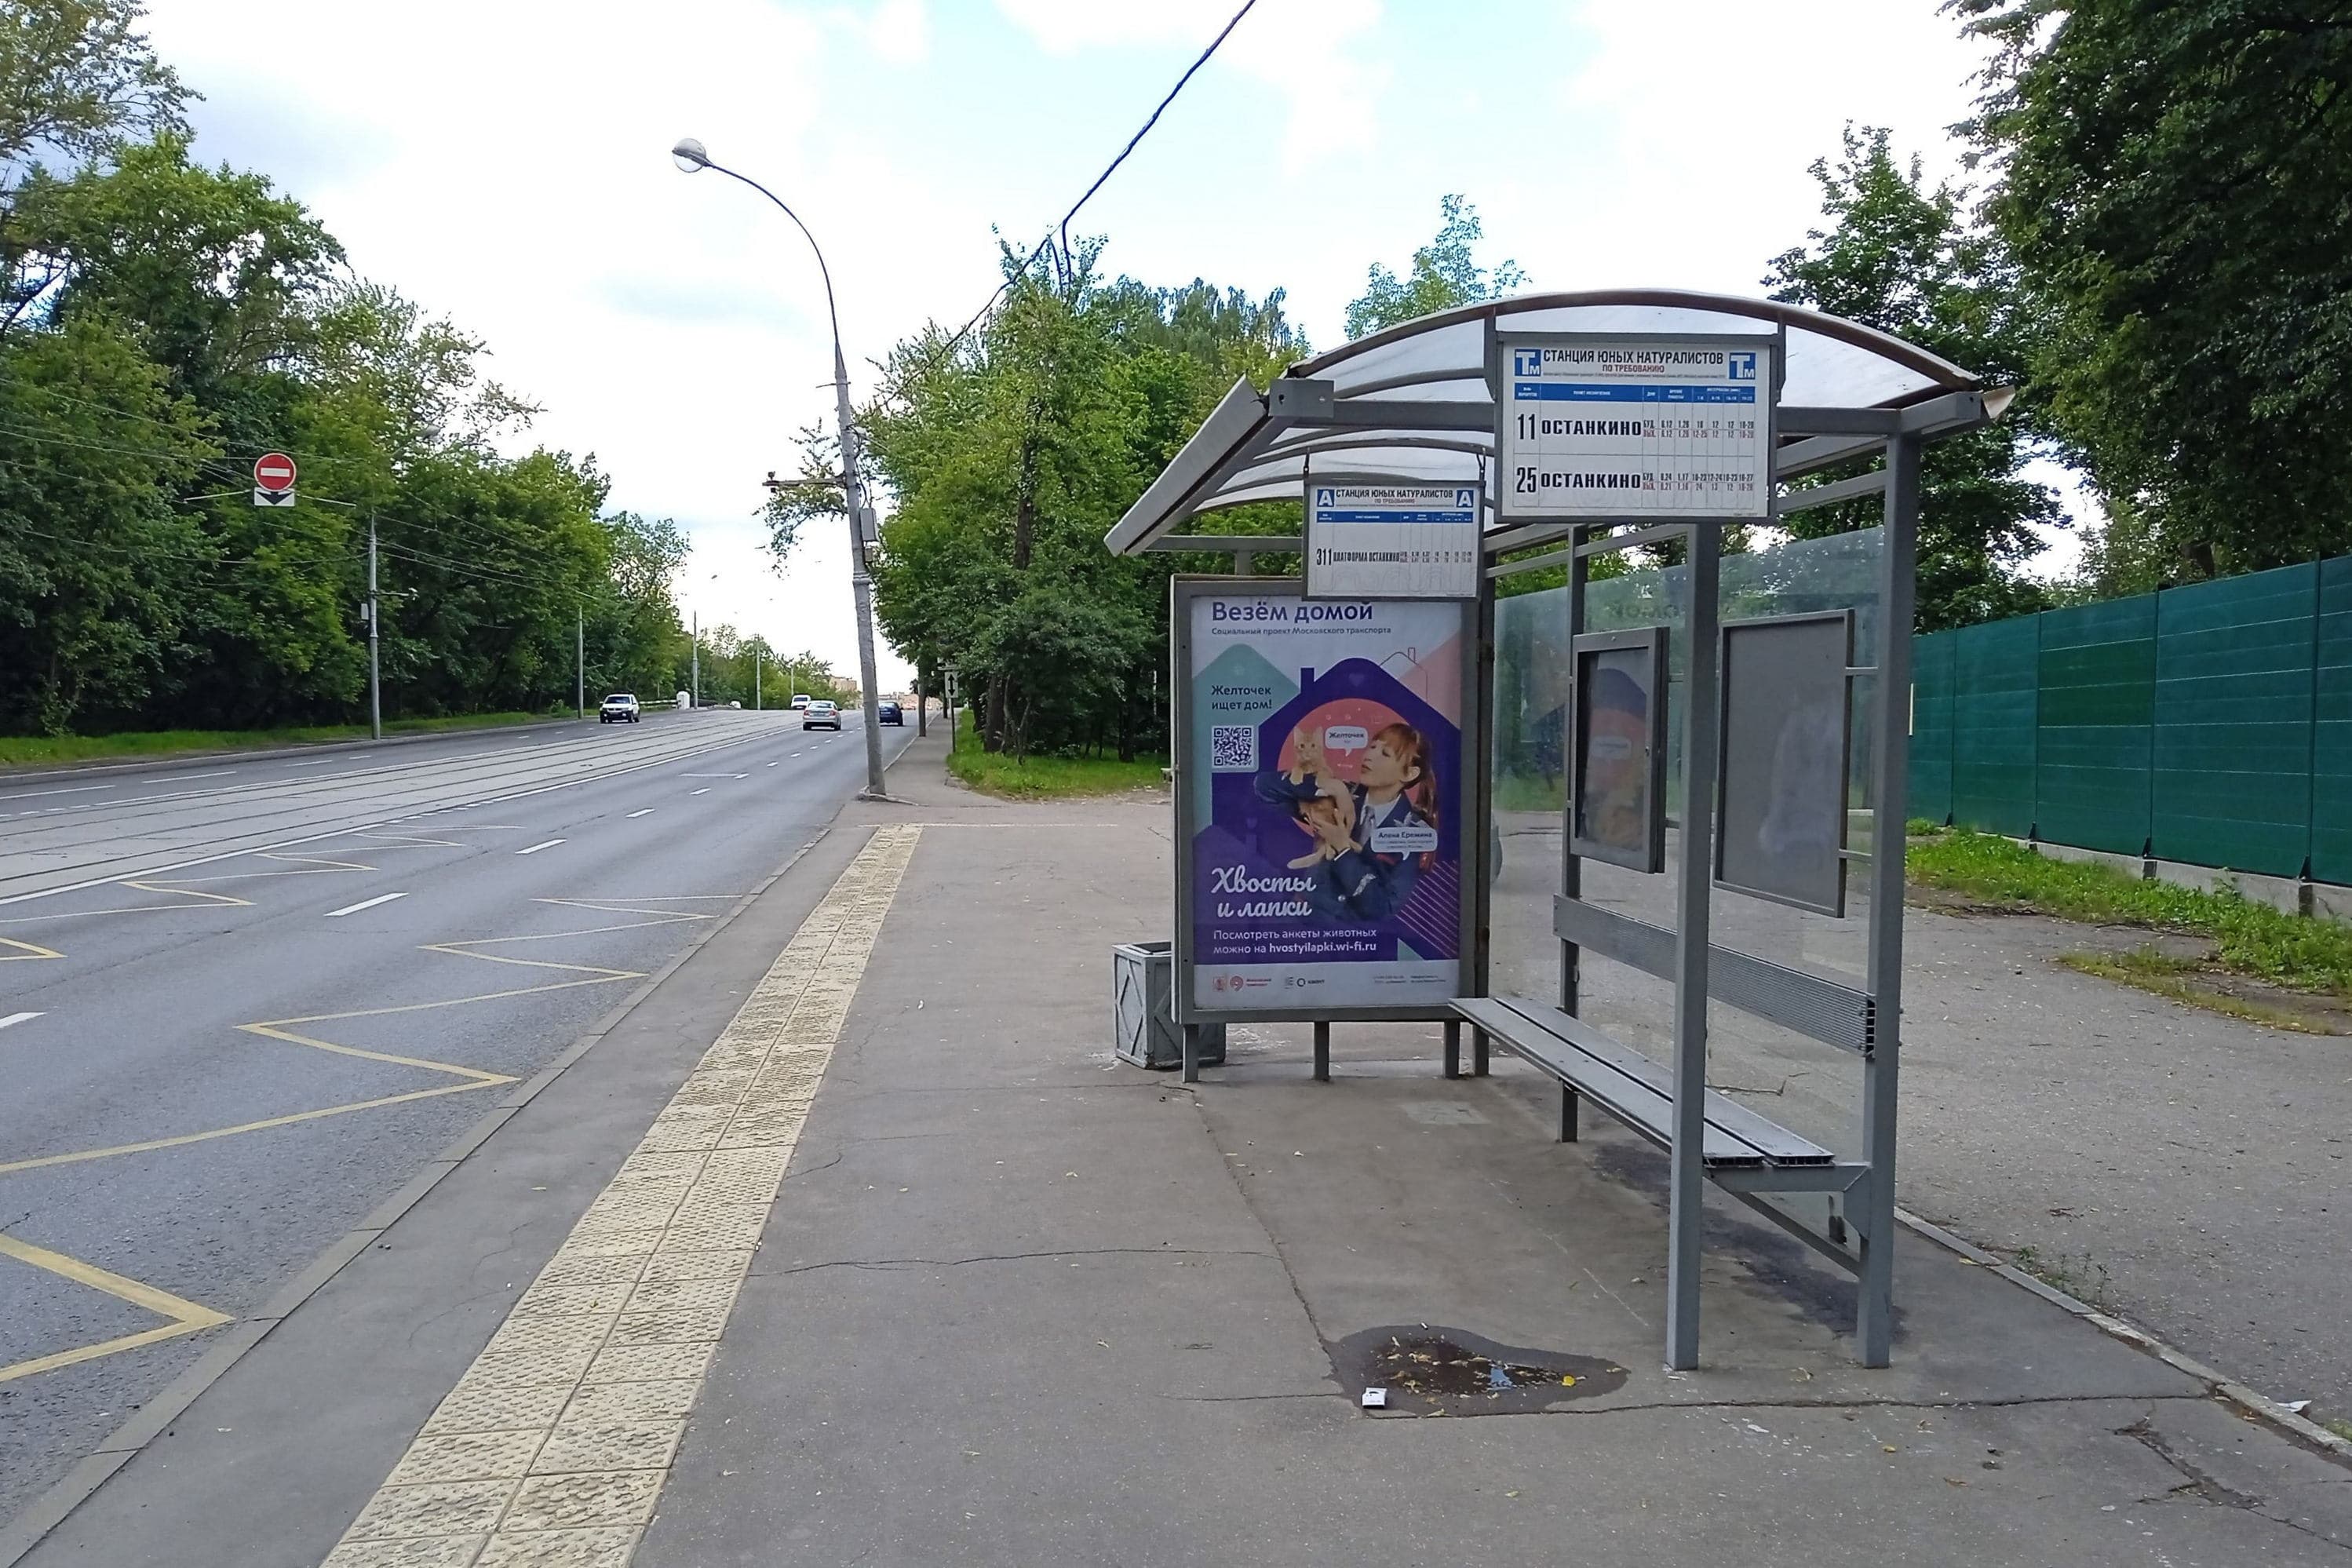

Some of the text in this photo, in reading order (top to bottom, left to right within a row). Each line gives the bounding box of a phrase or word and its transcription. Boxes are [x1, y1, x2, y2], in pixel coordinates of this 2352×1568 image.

[1544, 349, 1723, 364] СТАНЦИЯ ЮНЫХ НАТУРАЛИСТОВ
[1615, 364, 1665, 373] ТРЕБОВАНИЮ
[1518, 414, 1535, 439] 11
[1542, 420, 1641, 436] ОСТАНКИНО
[1516, 467, 1537, 493] 25
[1541, 473, 1640, 488] ОСТАНКИНО
[1318, 490, 1333, 506] А
[1336, 490, 1369, 498] СТАНЦИЯ
[1397, 490, 1453, 498] НАТУРАЛИСТОВ
[1457, 491, 1471, 506] А
[1317, 549, 1332, 565] 311
[1212, 602, 1372, 623] Везём домой
[1211, 685, 1271, 695] Желточек
[1212, 699, 1272, 711] ищет дом!
[1211, 864, 1317, 893] Хвосты
[1217, 902, 1312, 917] и лапки
[1213, 930, 1280, 939] Посмотреть
[1269, 941, 1377, 954] hvostyilapki.wi-fi.ru
